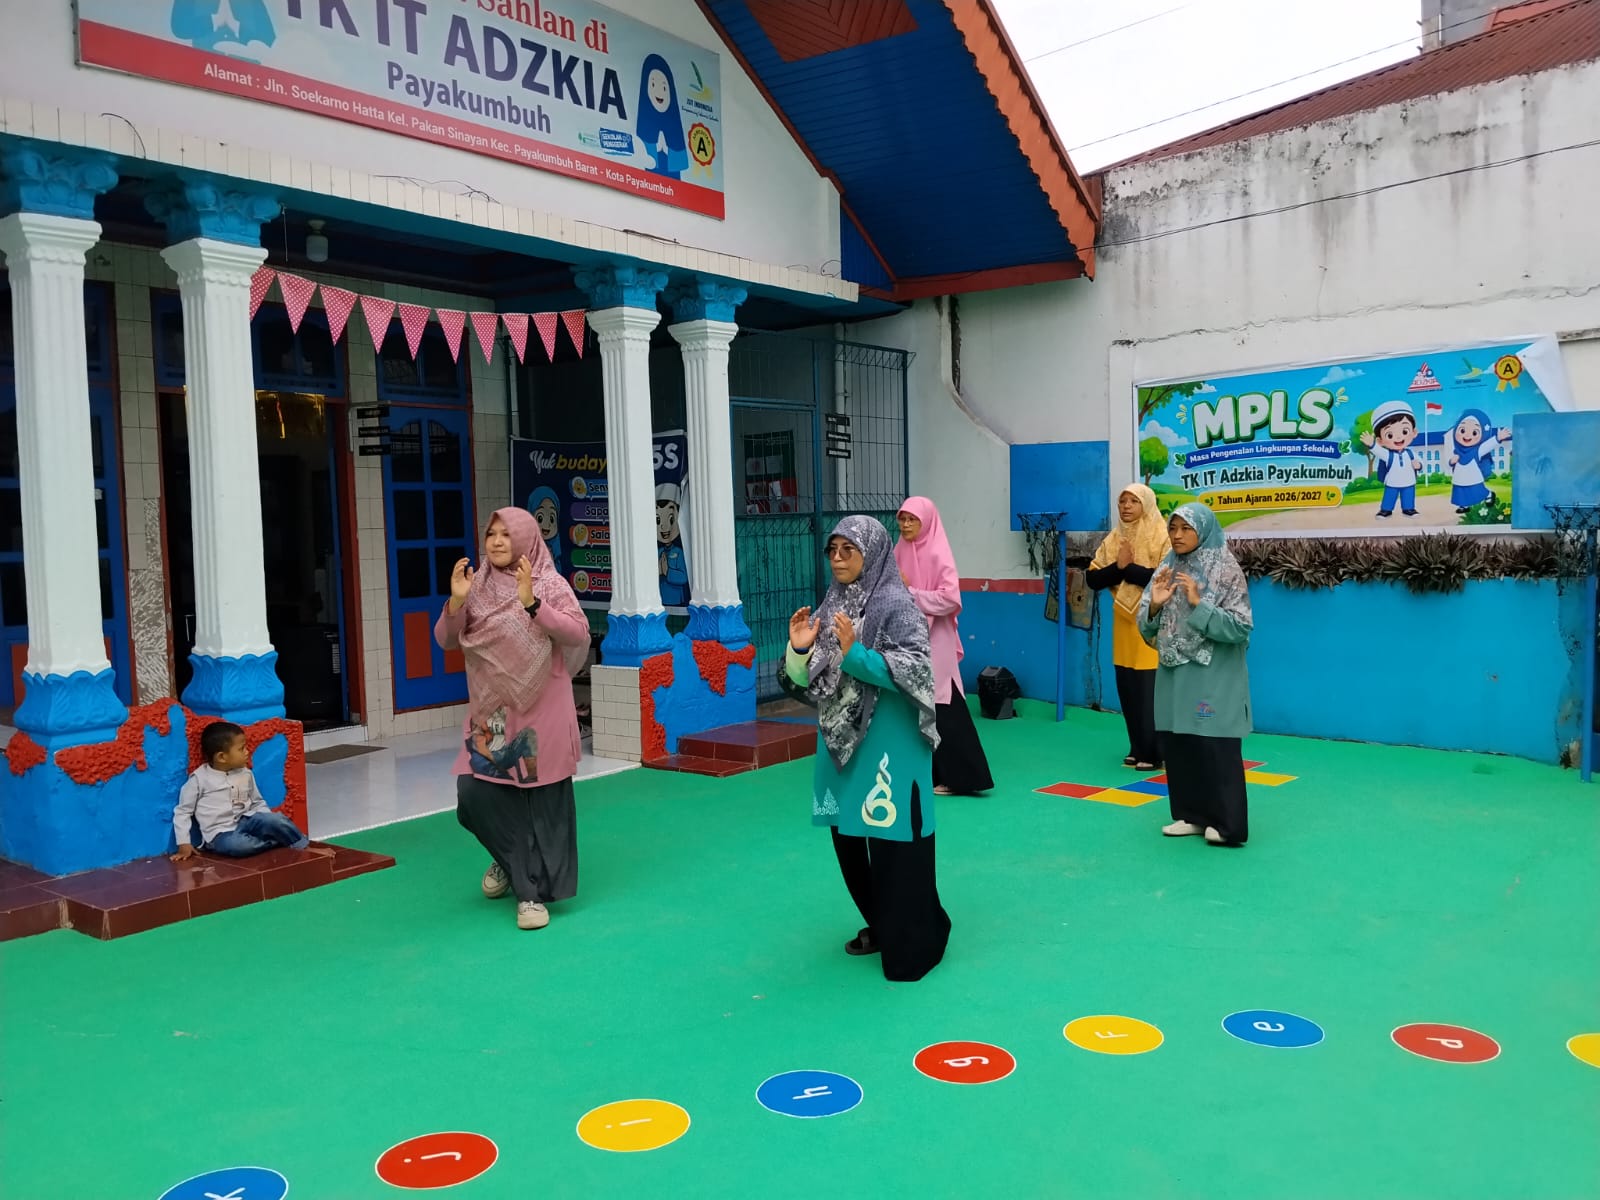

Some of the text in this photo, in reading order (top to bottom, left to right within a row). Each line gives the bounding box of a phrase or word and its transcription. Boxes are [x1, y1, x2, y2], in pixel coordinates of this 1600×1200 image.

[584, 19, 608, 54] di
[376, 0, 427, 55] IT
[444, 14, 627, 120] ADZKIA
[387, 61, 551, 134] Payakumbuh
[204, 63, 252, 86] Alamat
[263, 79, 288, 96] Jln.
[291, 85, 350, 111] Soekarno
[352, 101, 385, 121] Hatta
[387, 110, 408, 127] Kel.
[411, 117, 445, 136] Pakan
[448, 127, 488, 147] Sinayan
[490, 138, 512, 154] Kec.
[514, 144, 573, 168] Payakumbuh
[575, 160, 598, 176] Barat
[605, 168, 624, 183] Kota
[626, 174, 674, 196] Payakumbuh
[697, 137, 708, 157] A
[1503, 363, 1514, 375] A
[1192, 389, 1334, 449] MPLS
[529, 450, 557, 475] Yuk
[556, 454, 607, 473] buday
[1189, 443, 1335, 463] Masa Pengenalan Lingkungan Sekolah
[1181, 464, 1353, 489] TK IT Adzkia Payakumbuh
[1217, 491, 1322, 507] Tahun Ajaran 2026/2027
[590, 529, 610, 540] Sala
[591, 576, 612, 588] Sant
[1253, 1020, 1285, 1033] e
